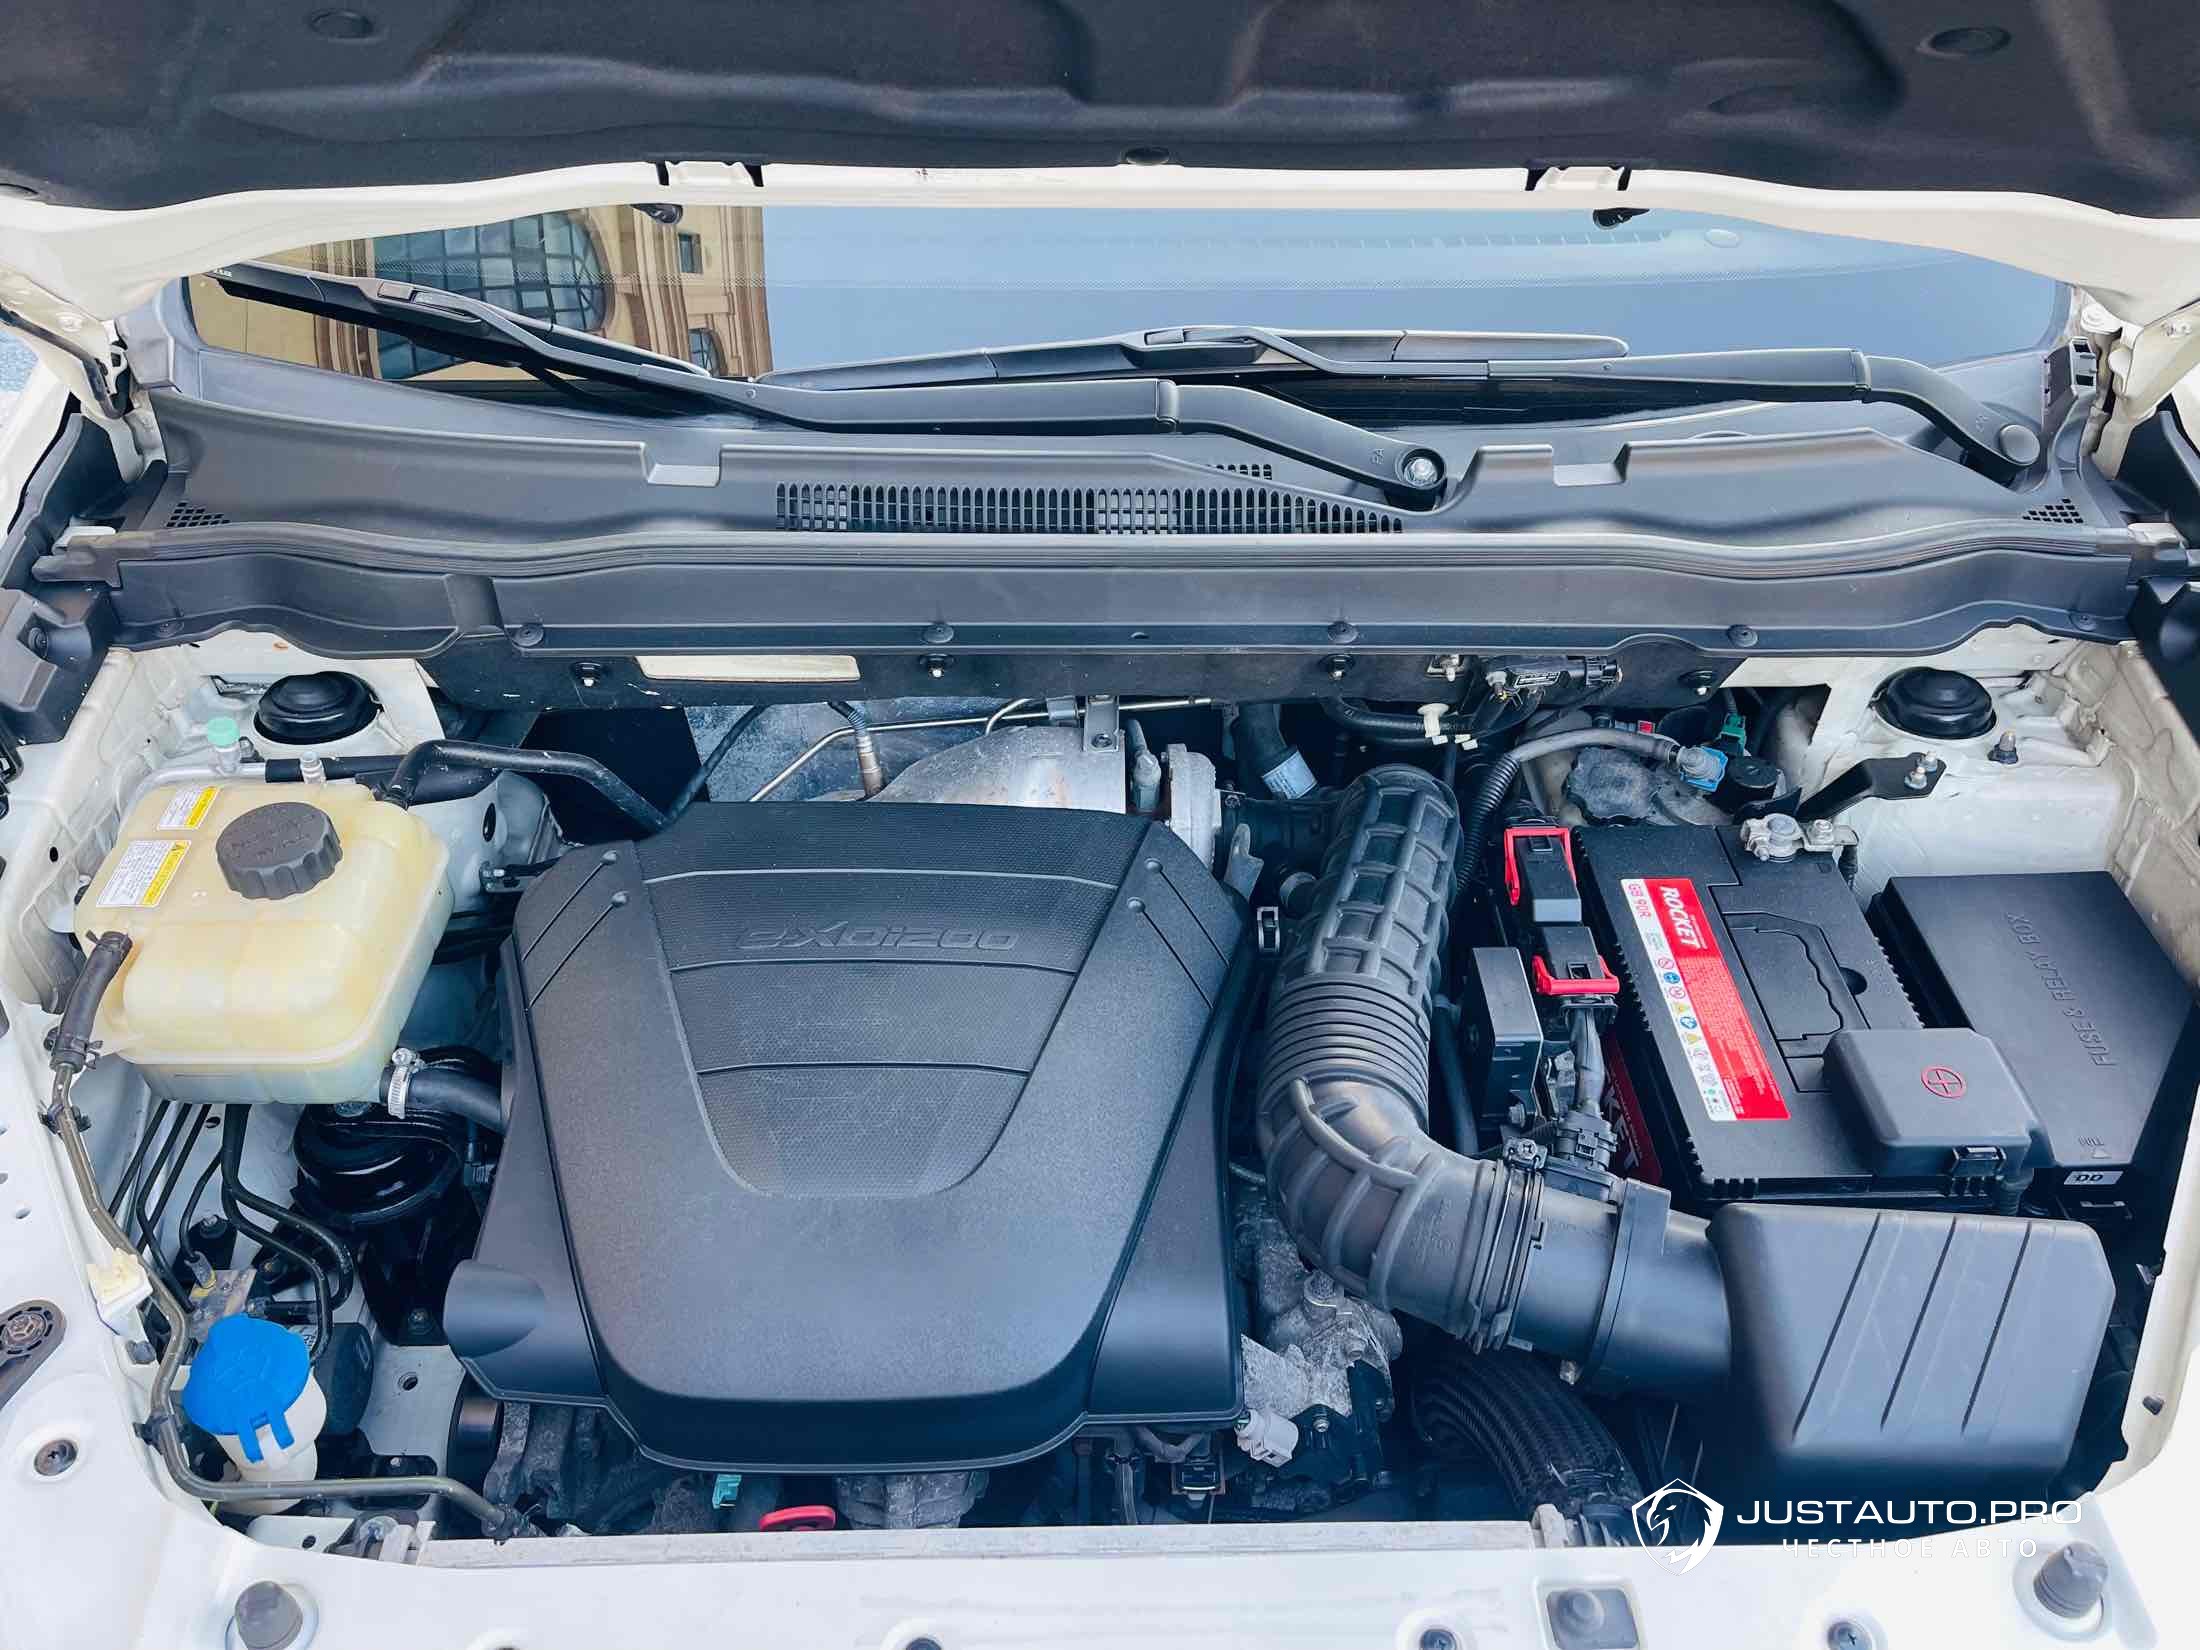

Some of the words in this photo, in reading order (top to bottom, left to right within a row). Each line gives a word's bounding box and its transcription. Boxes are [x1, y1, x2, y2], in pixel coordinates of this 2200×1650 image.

[1659, 885, 1702, 950] ROCKET
[2005, 911, 2042, 945] BOX
[2071, 1021, 2119, 1066] FUSE
